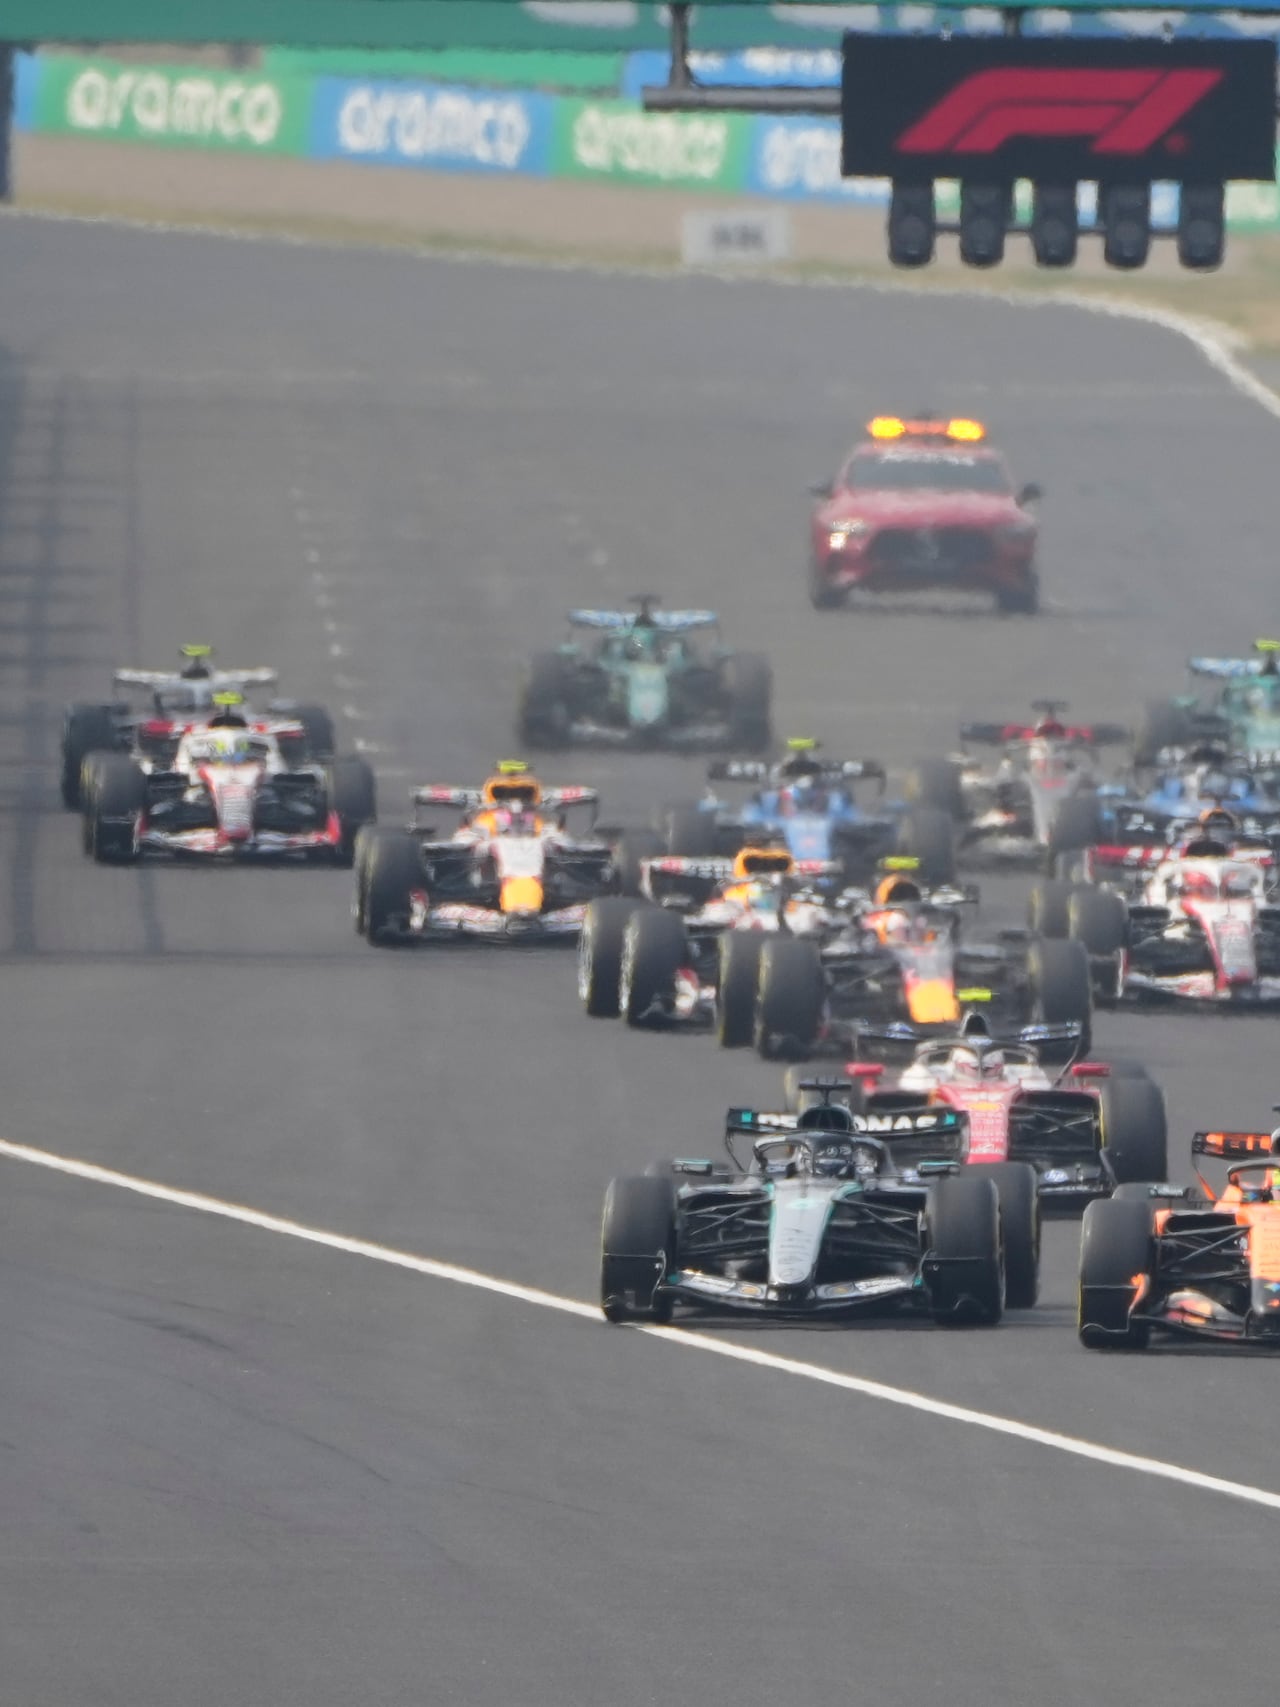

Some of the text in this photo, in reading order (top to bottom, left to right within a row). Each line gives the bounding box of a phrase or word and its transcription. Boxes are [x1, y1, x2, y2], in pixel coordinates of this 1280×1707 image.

[66, 68, 283, 145] aramco
[338, 87, 530, 170] aramco
[896, 67, 1223, 152] F1
